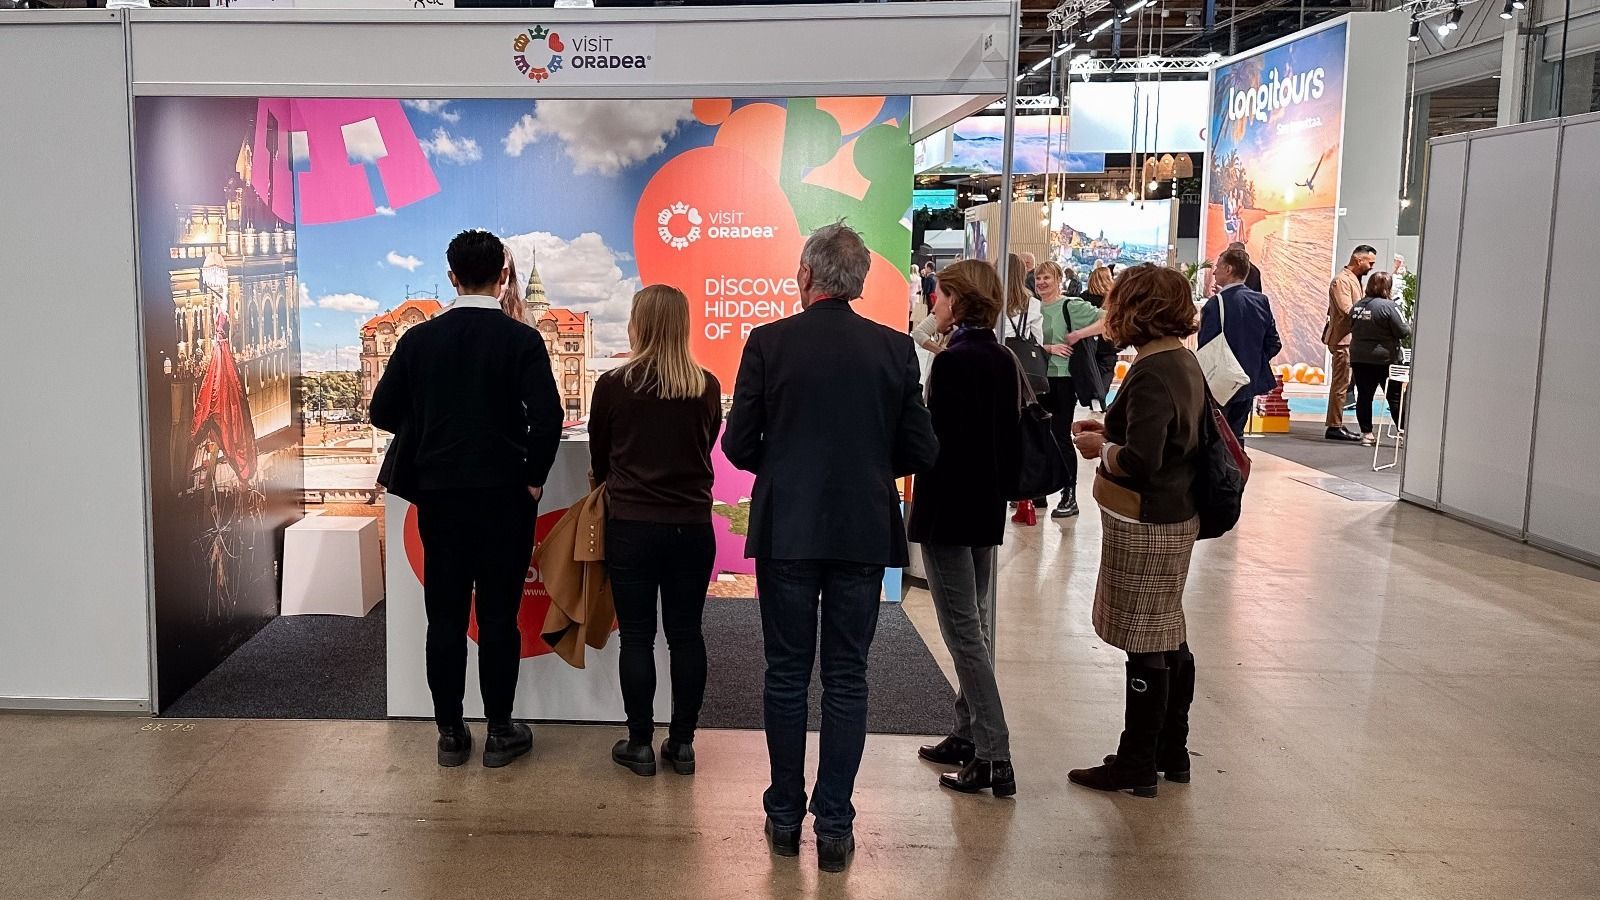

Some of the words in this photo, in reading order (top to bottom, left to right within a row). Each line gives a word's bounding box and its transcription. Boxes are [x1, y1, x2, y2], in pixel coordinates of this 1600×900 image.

[1228, 66, 1325, 122] longitours
[704, 274, 799, 296] DiSCOVe
[704, 322, 733, 340] OF
